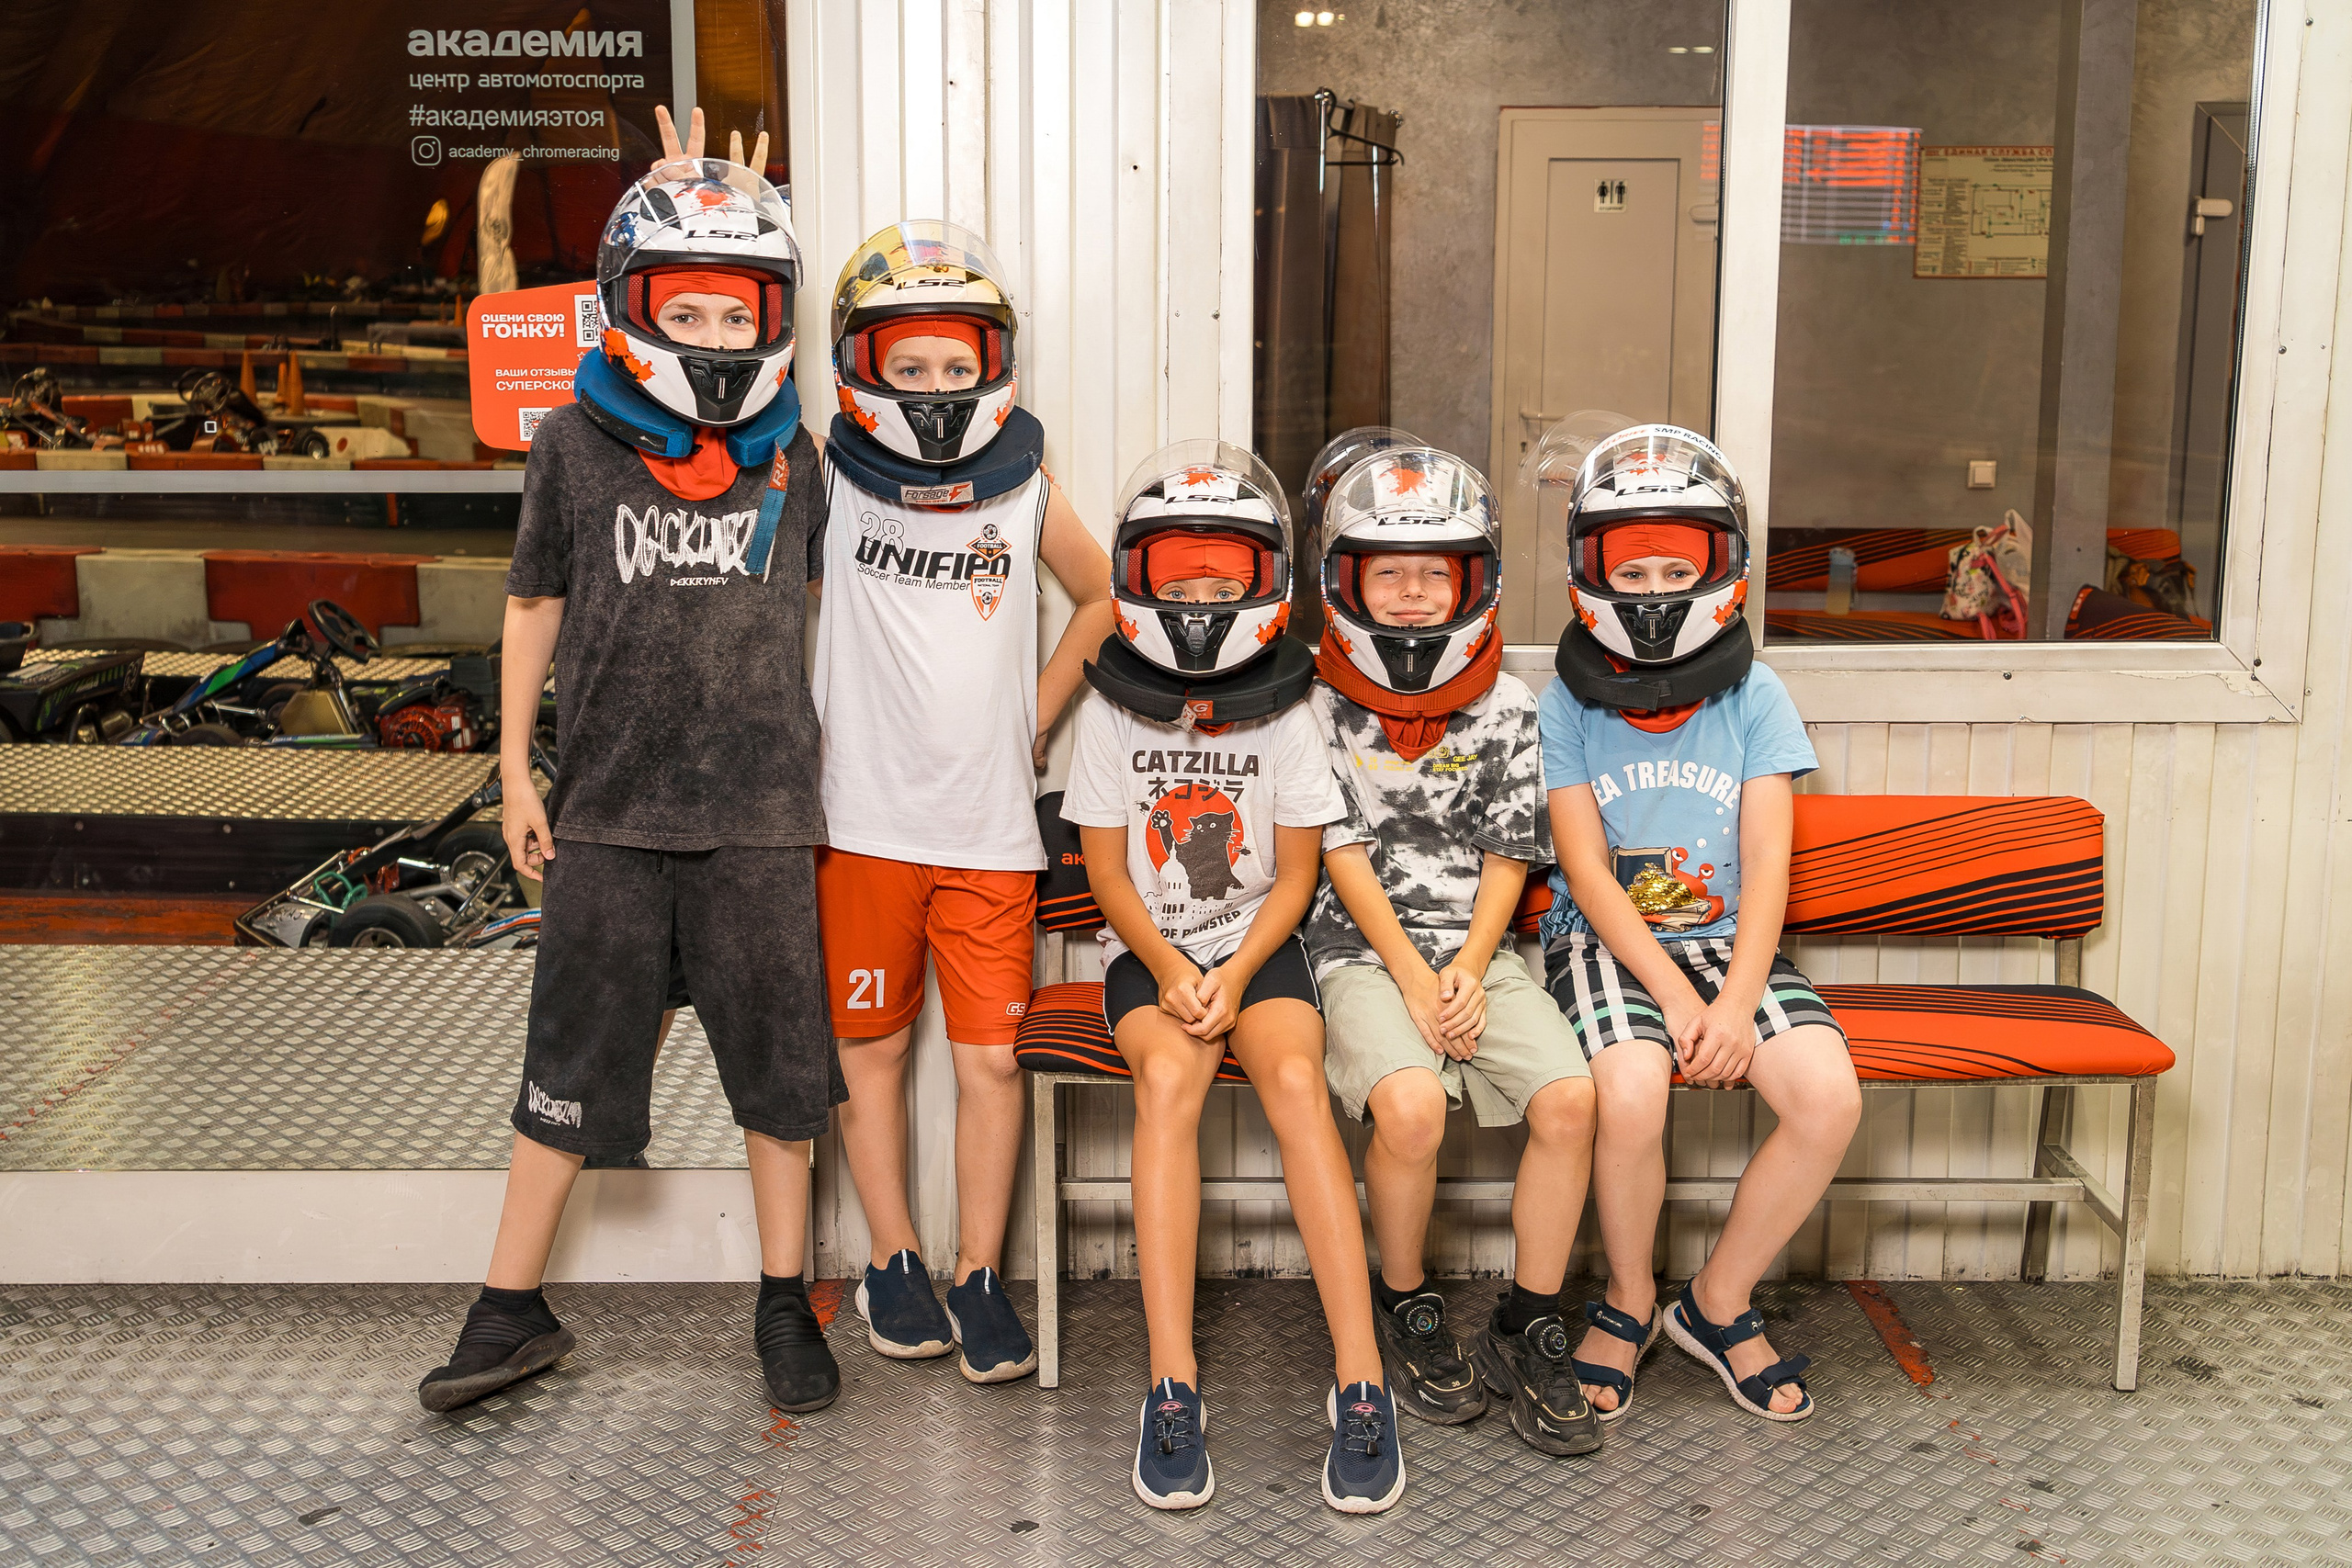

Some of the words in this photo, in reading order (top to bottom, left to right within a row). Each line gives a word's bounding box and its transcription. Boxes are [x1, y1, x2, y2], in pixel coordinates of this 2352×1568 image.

[407, 28, 643, 58] академия
[410, 73, 470, 93] центр
[478, 73, 645, 93] автомотоспорта
[409, 104, 605, 130] #академияэтоя
[448, 145, 620, 162] academy_chromeracing
[684, 230, 759, 242] LS2
[896, 278, 967, 291] LS2
[481, 314, 525, 322] ОЦЕНИ
[526, 314, 565, 322] СВОЮ
[482, 323, 565, 338] ГОНКУ!
[495, 368, 528, 377] ВАШИ
[530, 368, 578, 377] ОТЗЫВЫ
[1683, 433, 1722, 460] RACING
[905, 489, 949, 500] Forsage
[1164, 494, 1236, 505] LS2
[1377, 515, 1448, 526] LS2
[860, 511, 904, 558] 28
[857, 562, 890, 581] Soccer
[893, 573, 922, 588] Team
[925, 579, 971, 591] Member
[1132, 750, 1260, 777] CATZILLA
[1148, 776, 1244, 803] ネコジラ
[1623, 760, 1741, 809] TREASURE
[1159, 929, 1178, 939] OF
[847, 968, 885, 1010] 21
